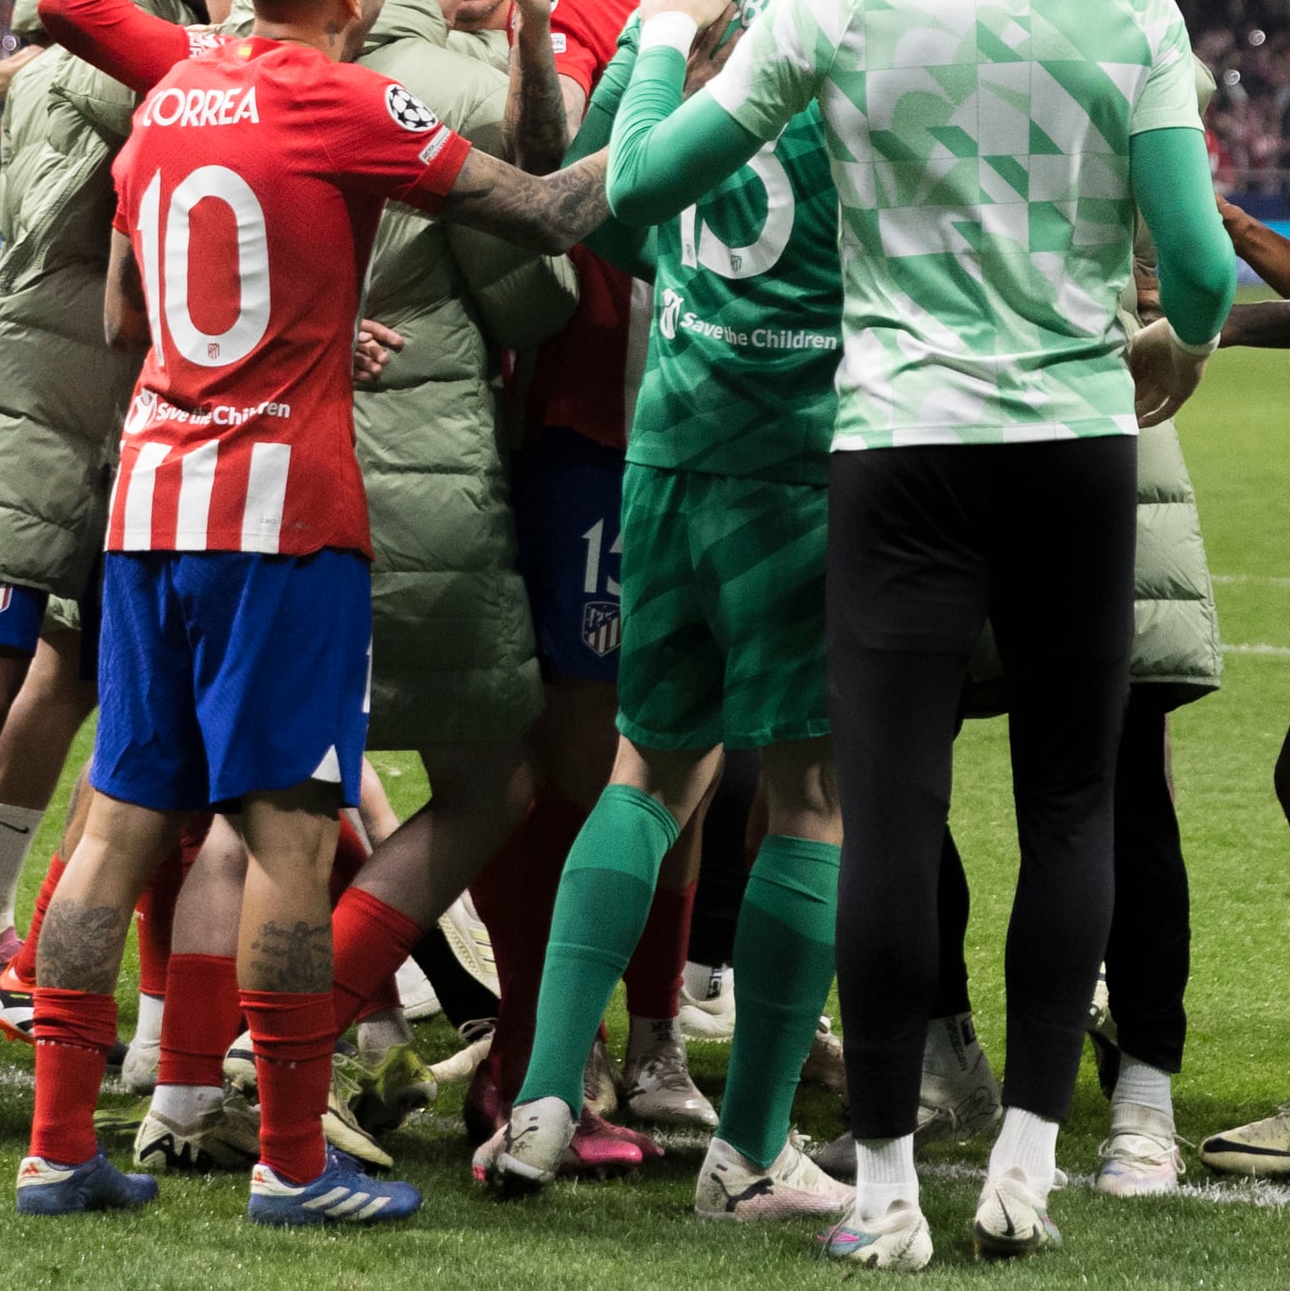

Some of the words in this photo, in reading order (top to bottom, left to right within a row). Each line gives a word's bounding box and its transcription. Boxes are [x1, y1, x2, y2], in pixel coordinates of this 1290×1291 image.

[143, 86, 259, 127] CORREA
[137, 164, 271, 368] 10
[679, 311, 723, 340] Save
[724, 326, 748, 347] the
[751, 328, 838, 350] Children
